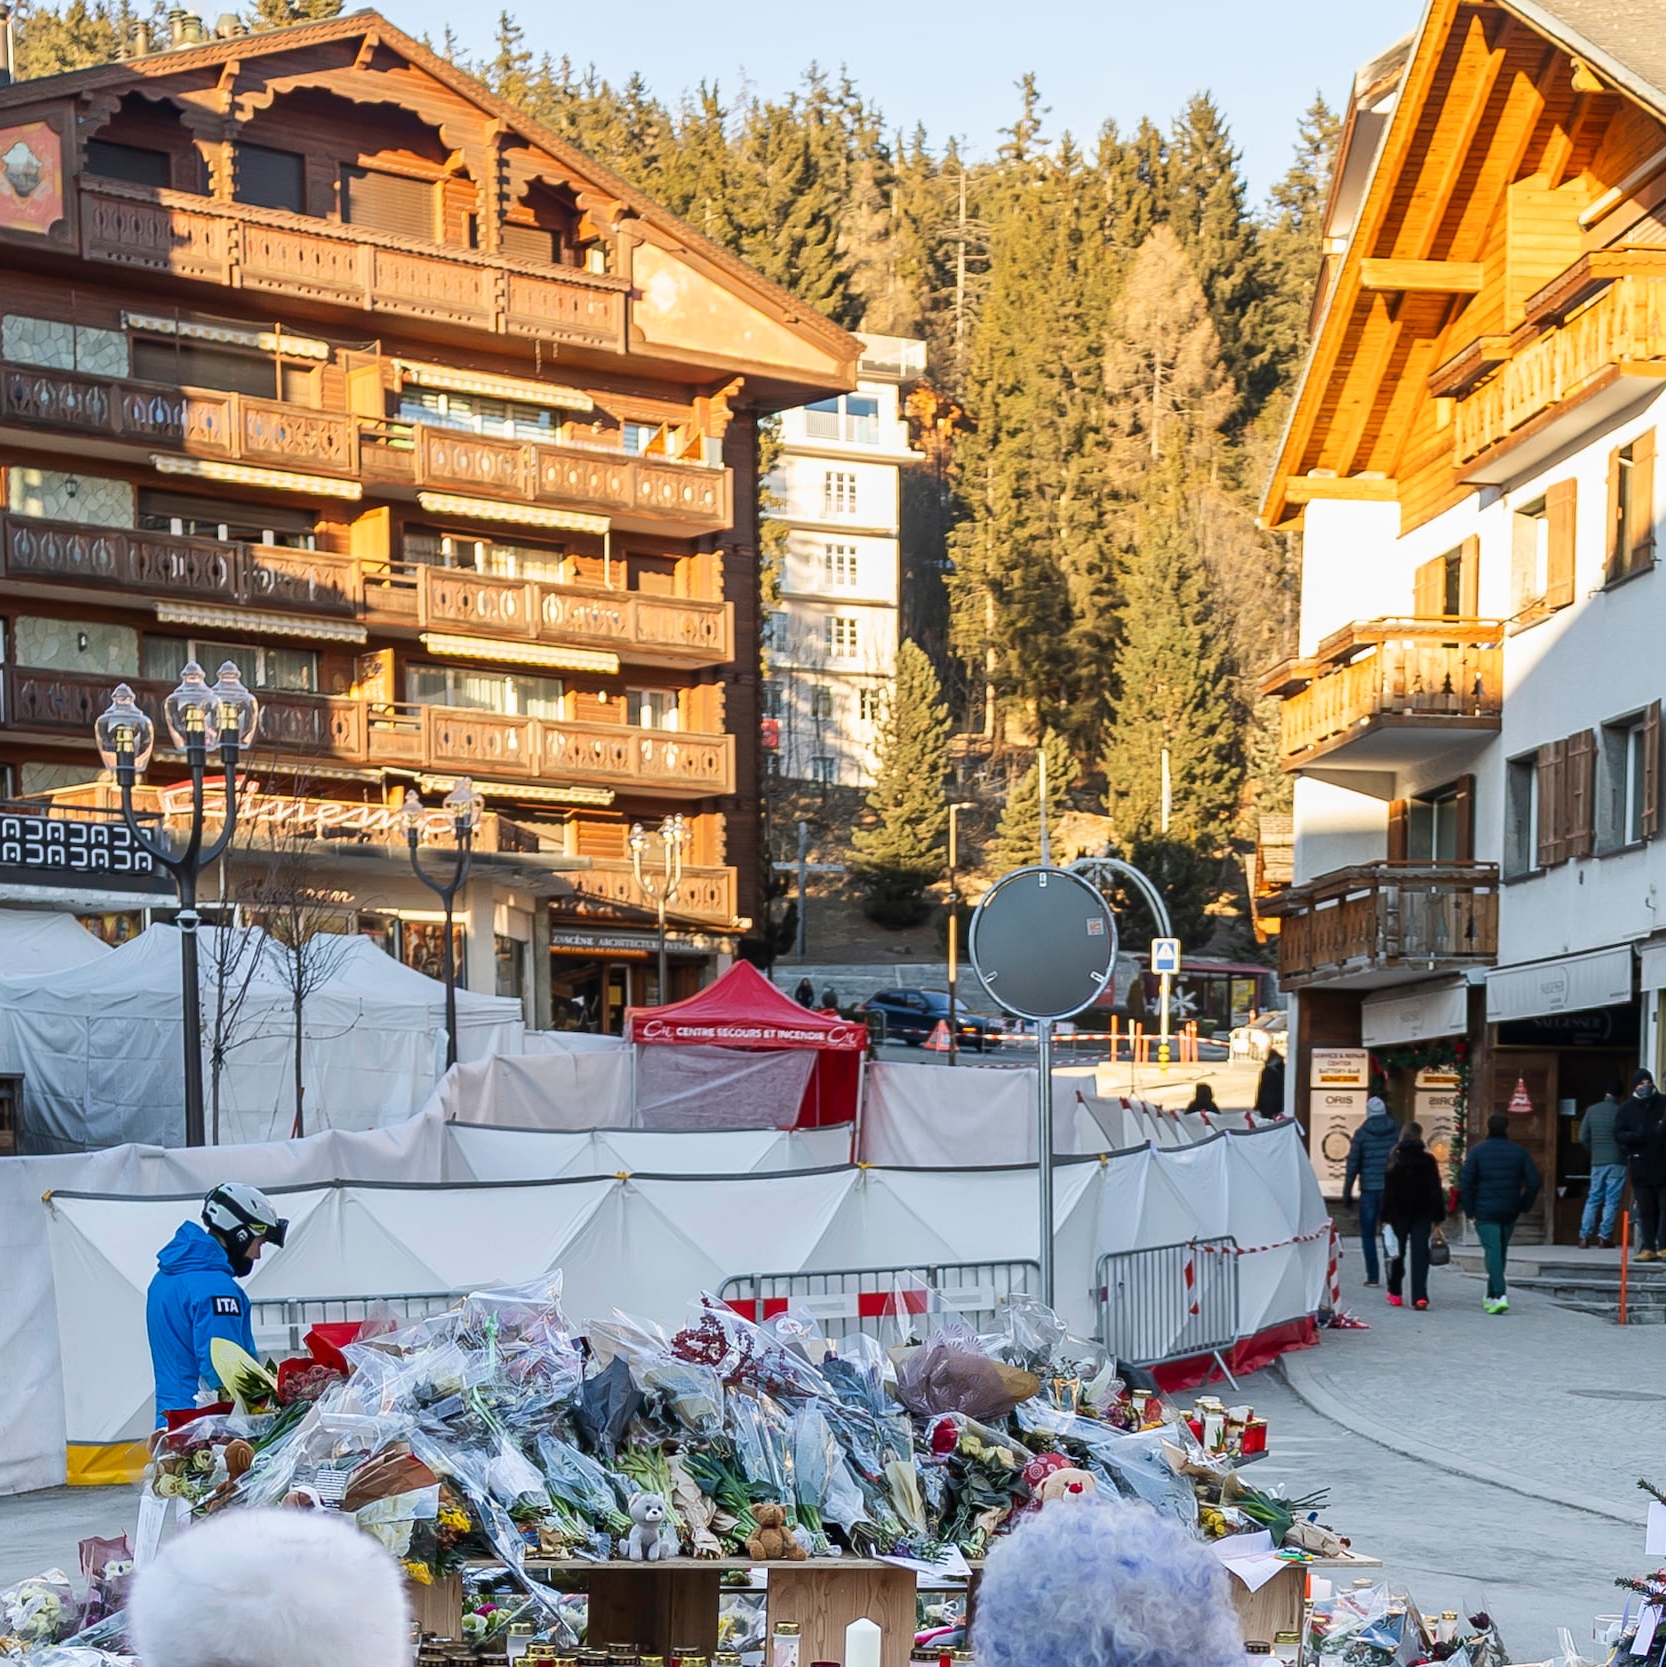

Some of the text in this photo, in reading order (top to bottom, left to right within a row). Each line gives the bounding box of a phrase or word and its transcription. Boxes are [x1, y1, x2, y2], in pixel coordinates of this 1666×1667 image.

[676, 1027, 825, 1041] CENTRE SECOURS ET INCENDIE
[216, 1297, 239, 1314] ITA
